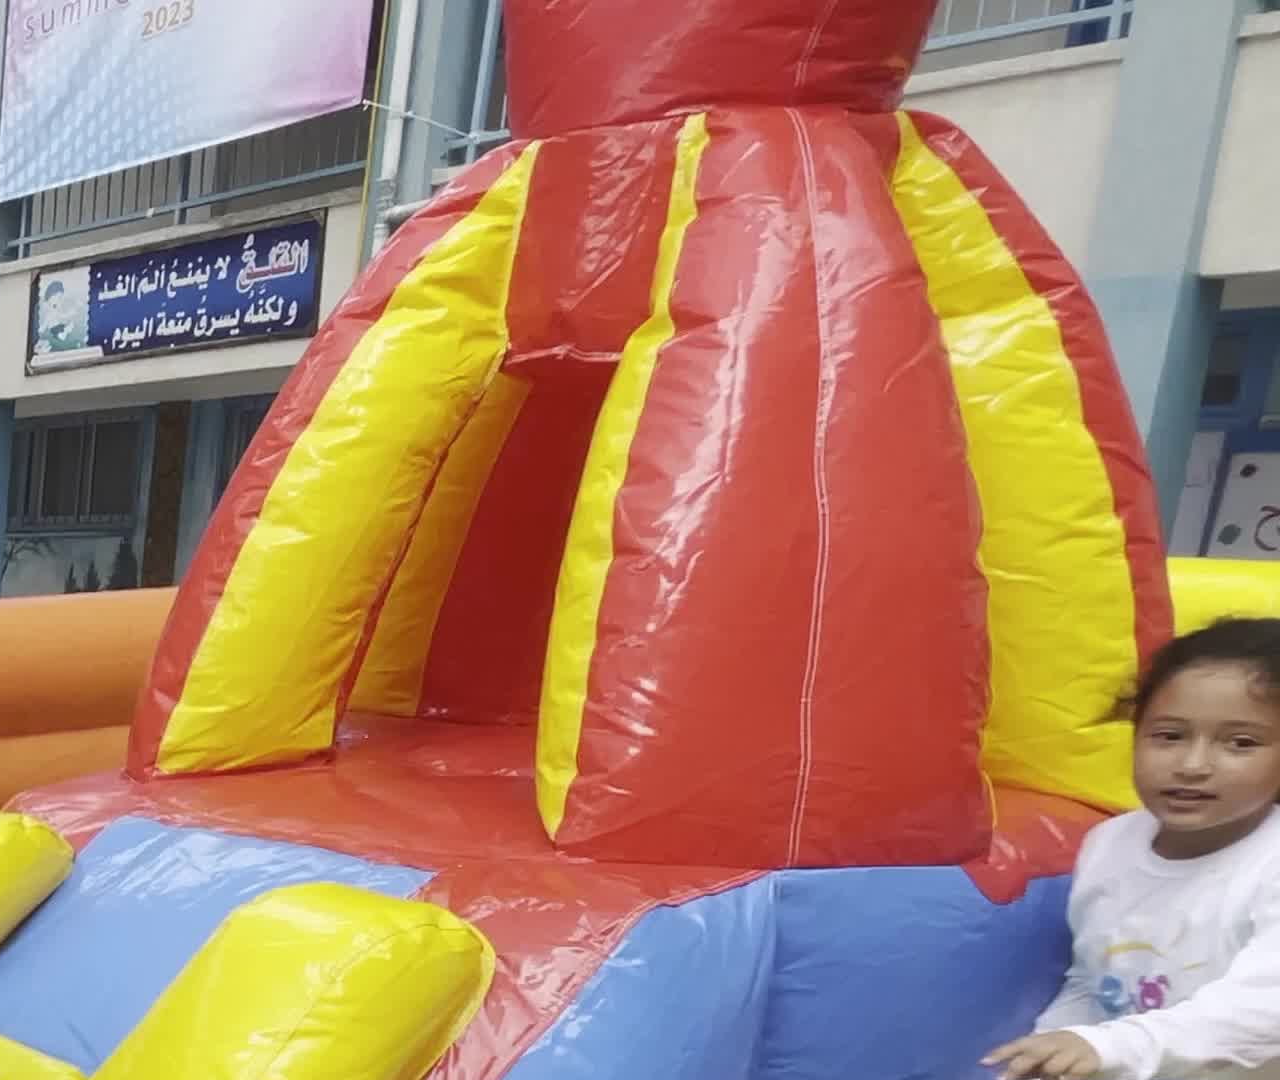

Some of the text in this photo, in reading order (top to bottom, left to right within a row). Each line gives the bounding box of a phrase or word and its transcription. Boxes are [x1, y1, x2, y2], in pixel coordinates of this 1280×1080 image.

[24, 0, 129, 41] summ
[142, 0, 195, 37] 2023
[213, 255, 232, 281] لا
